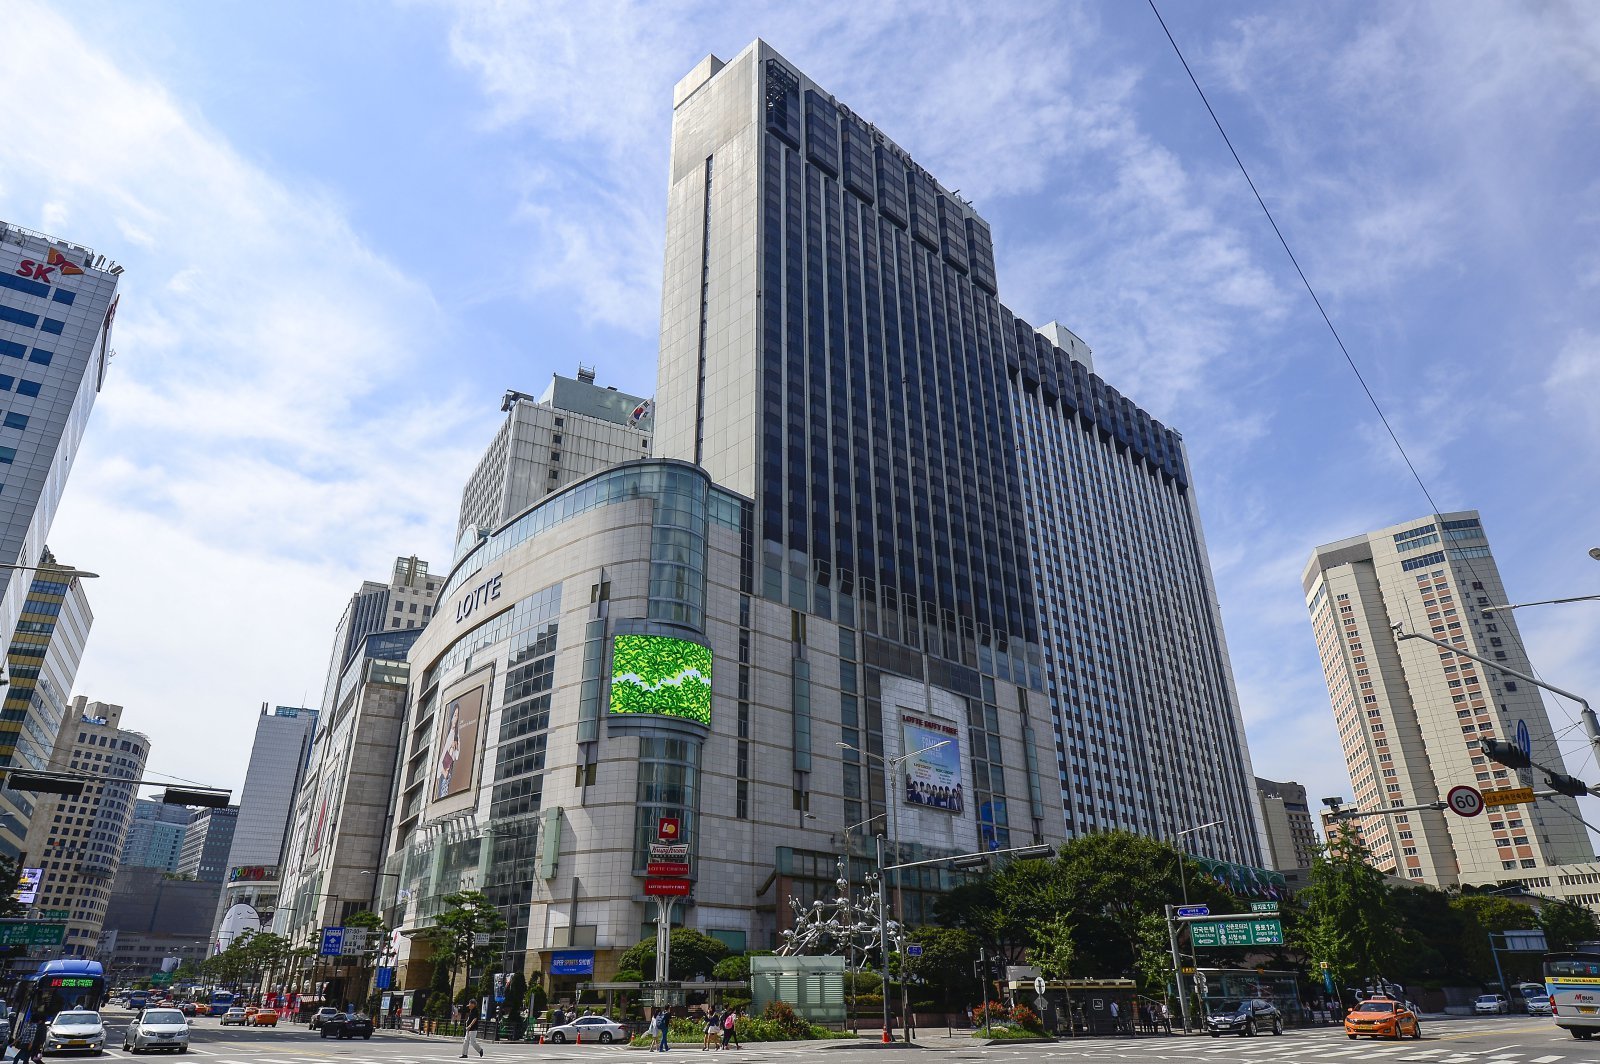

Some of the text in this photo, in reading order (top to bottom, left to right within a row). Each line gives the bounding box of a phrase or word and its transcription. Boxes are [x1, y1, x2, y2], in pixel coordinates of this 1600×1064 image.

[16, 259, 55, 284] SK
[456, 572, 503, 624] LOTTE
[902, 714, 958, 735] LOTTE DUTY FREE
[1455, 794, 1476, 809] 60
[231, 866, 264, 881] young
[1255, 924, 1276, 932] 종로1가
[578, 958, 591, 966] SHOW
